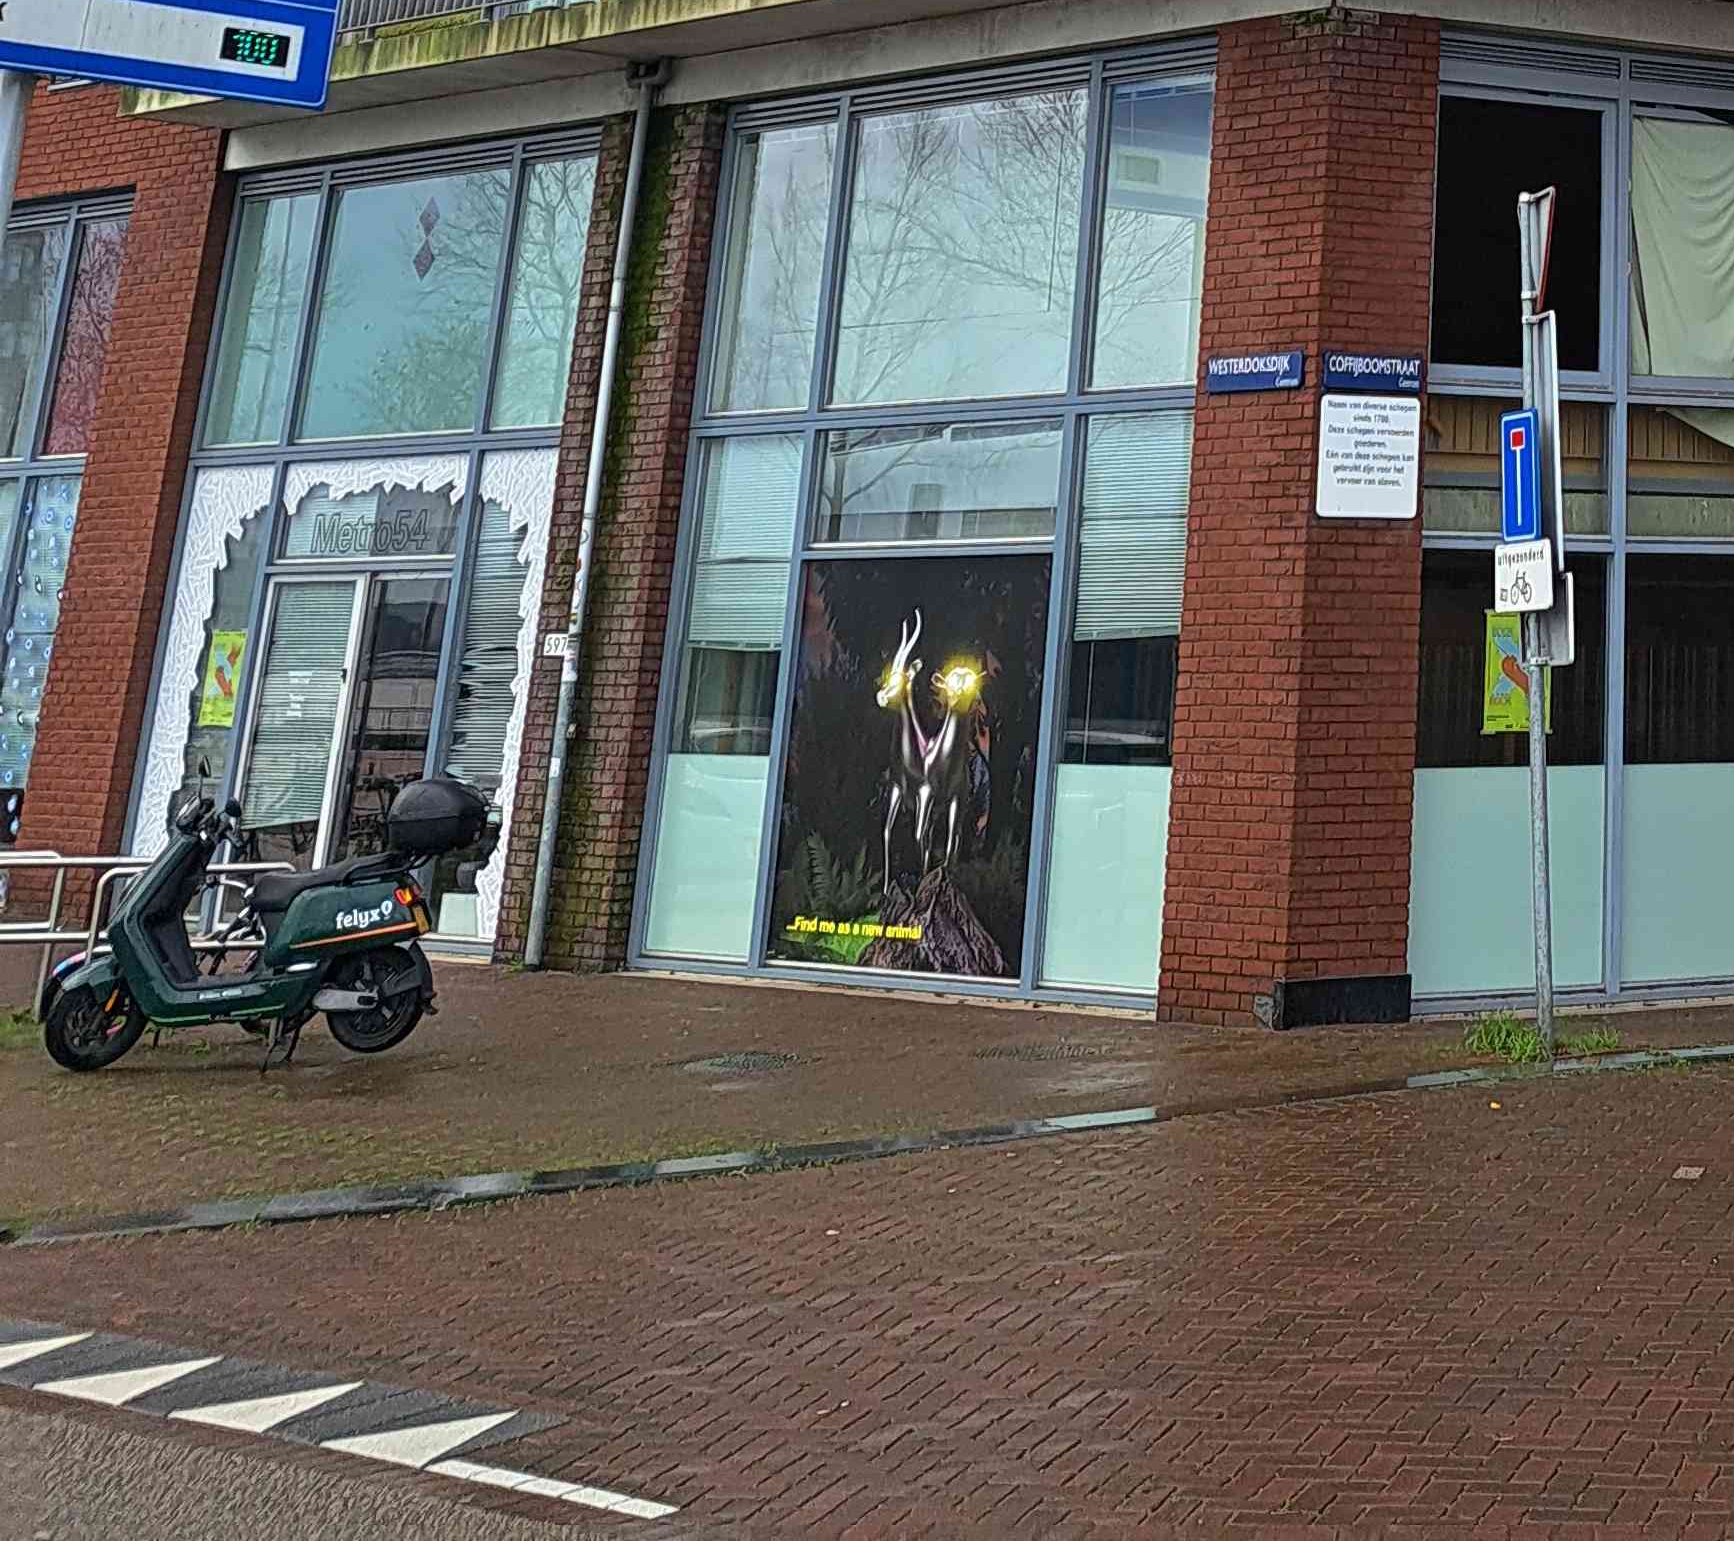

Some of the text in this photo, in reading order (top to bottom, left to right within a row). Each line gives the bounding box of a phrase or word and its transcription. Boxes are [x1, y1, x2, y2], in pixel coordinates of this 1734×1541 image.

[1208, 355, 1291, 375] WESTERDOKSDIJK
[1329, 355, 1421, 377] COFFIJBOOMSTRAAT
[310, 508, 430, 553] Metro54
[1498, 548, 1544, 568] uitgezonderd
[546, 637, 567, 654] 597
[336, 908, 380, 929] felyx
[819, 920, 835, 933] me
[838, 922, 850, 934] as
[862, 924, 884, 936] new
[885, 924, 922, 939] animal
